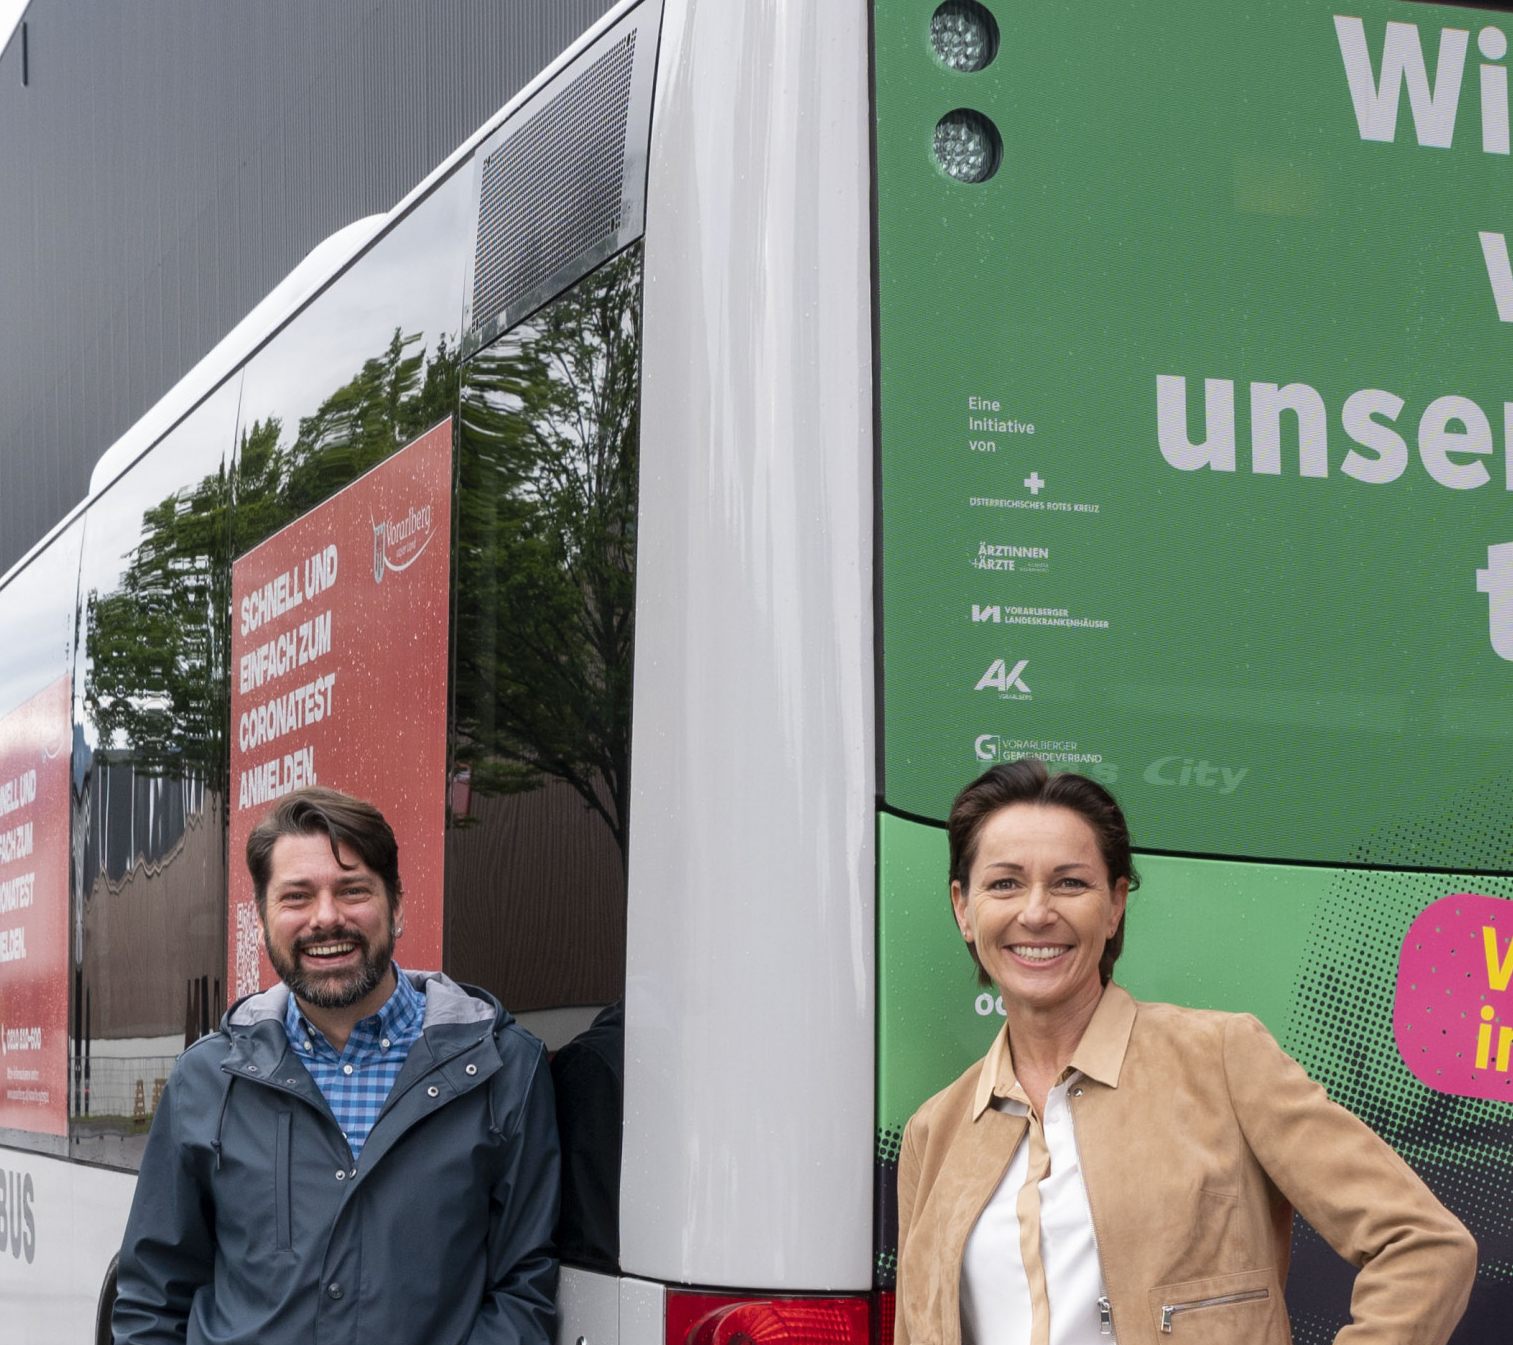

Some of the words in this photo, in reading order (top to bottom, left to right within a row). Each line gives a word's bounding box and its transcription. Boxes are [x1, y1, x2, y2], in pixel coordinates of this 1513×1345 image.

[968, 396, 1001, 411] Eine
[969, 417, 1035, 434] Initiative
[1156, 374, 1513, 491] unse
[969, 440, 996, 452] von
[1046, 501, 1072, 512] ROTES
[385, 504, 431, 547] Vorarlberg
[978, 541, 1049, 559] ÄRZTINNEN
[240, 566, 303, 637] SCHNELL
[304, 544, 338, 600] UND
[240, 629, 297, 695] EINFACH
[298, 610, 332, 667] ZUM
[974, 659, 1031, 692] AK
[239, 672, 336, 753] CORONATEST
[1002, 739, 1077, 752] VORARLBERGER
[239, 746, 317, 811] ANMELDEN.
[1143, 754, 1248, 795] City
